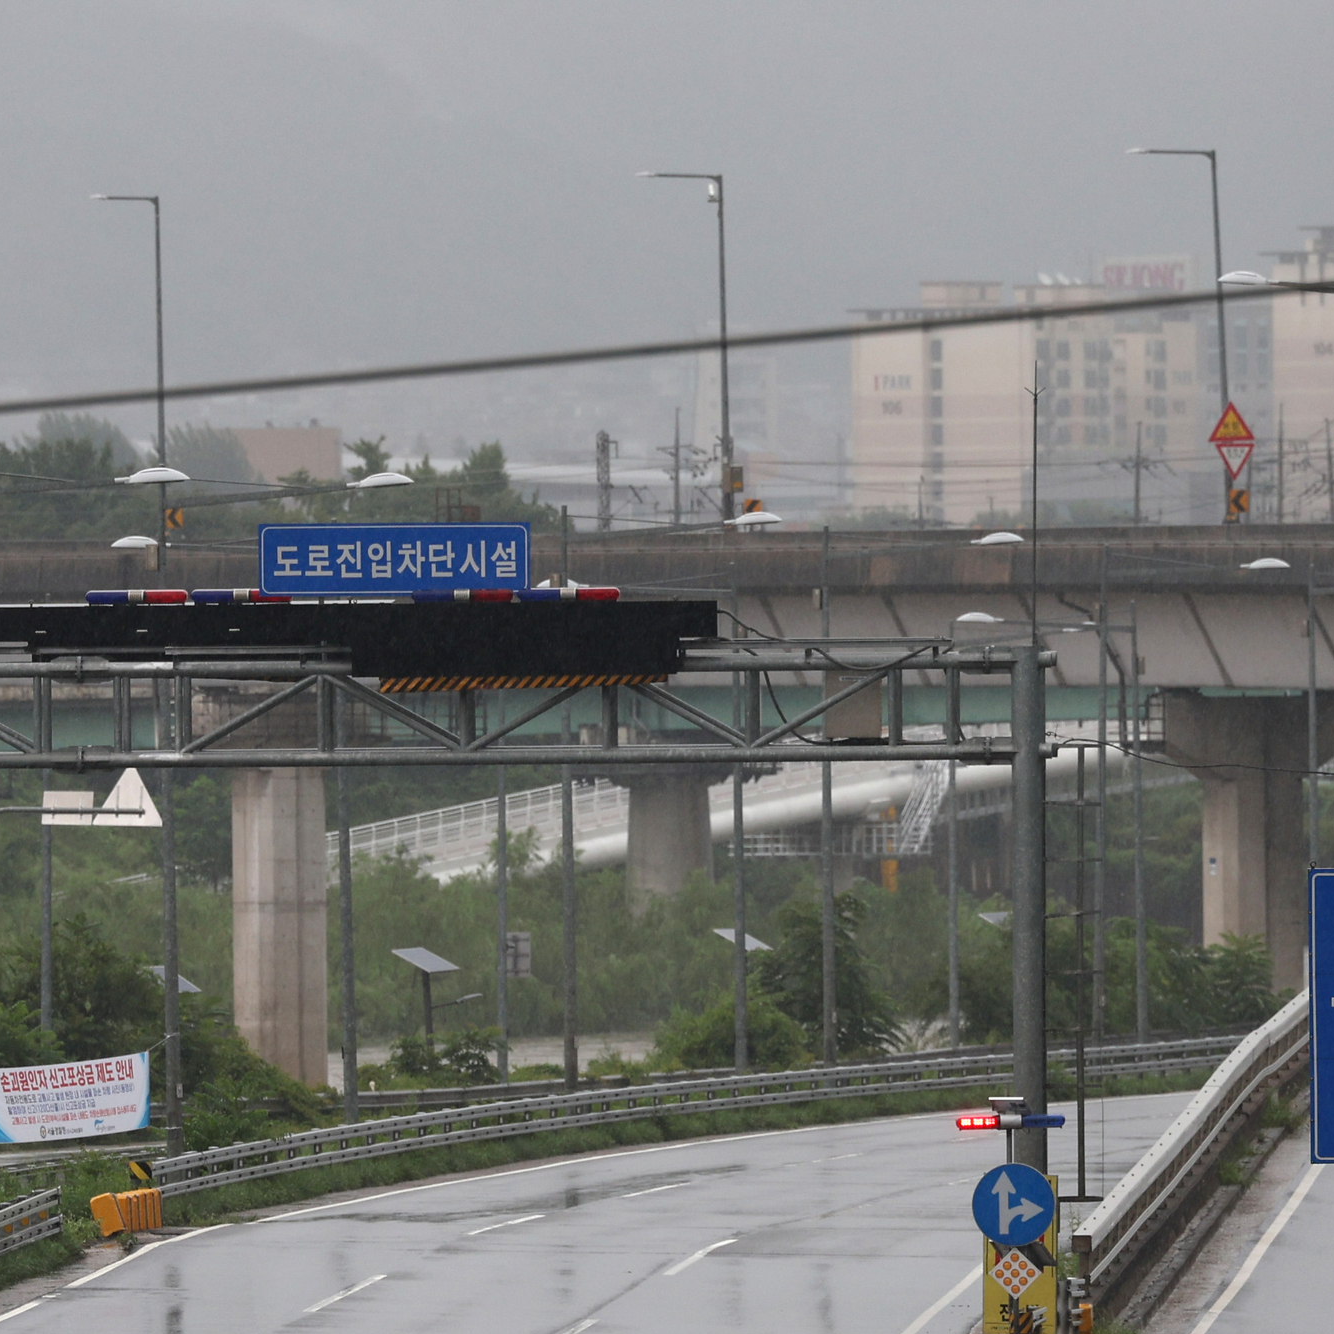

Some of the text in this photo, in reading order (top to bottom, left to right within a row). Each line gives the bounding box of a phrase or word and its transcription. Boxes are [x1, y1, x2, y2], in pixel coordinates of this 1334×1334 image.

[0, 1058, 134, 1093] 손괴원인자 신고포상금 제도 안내
